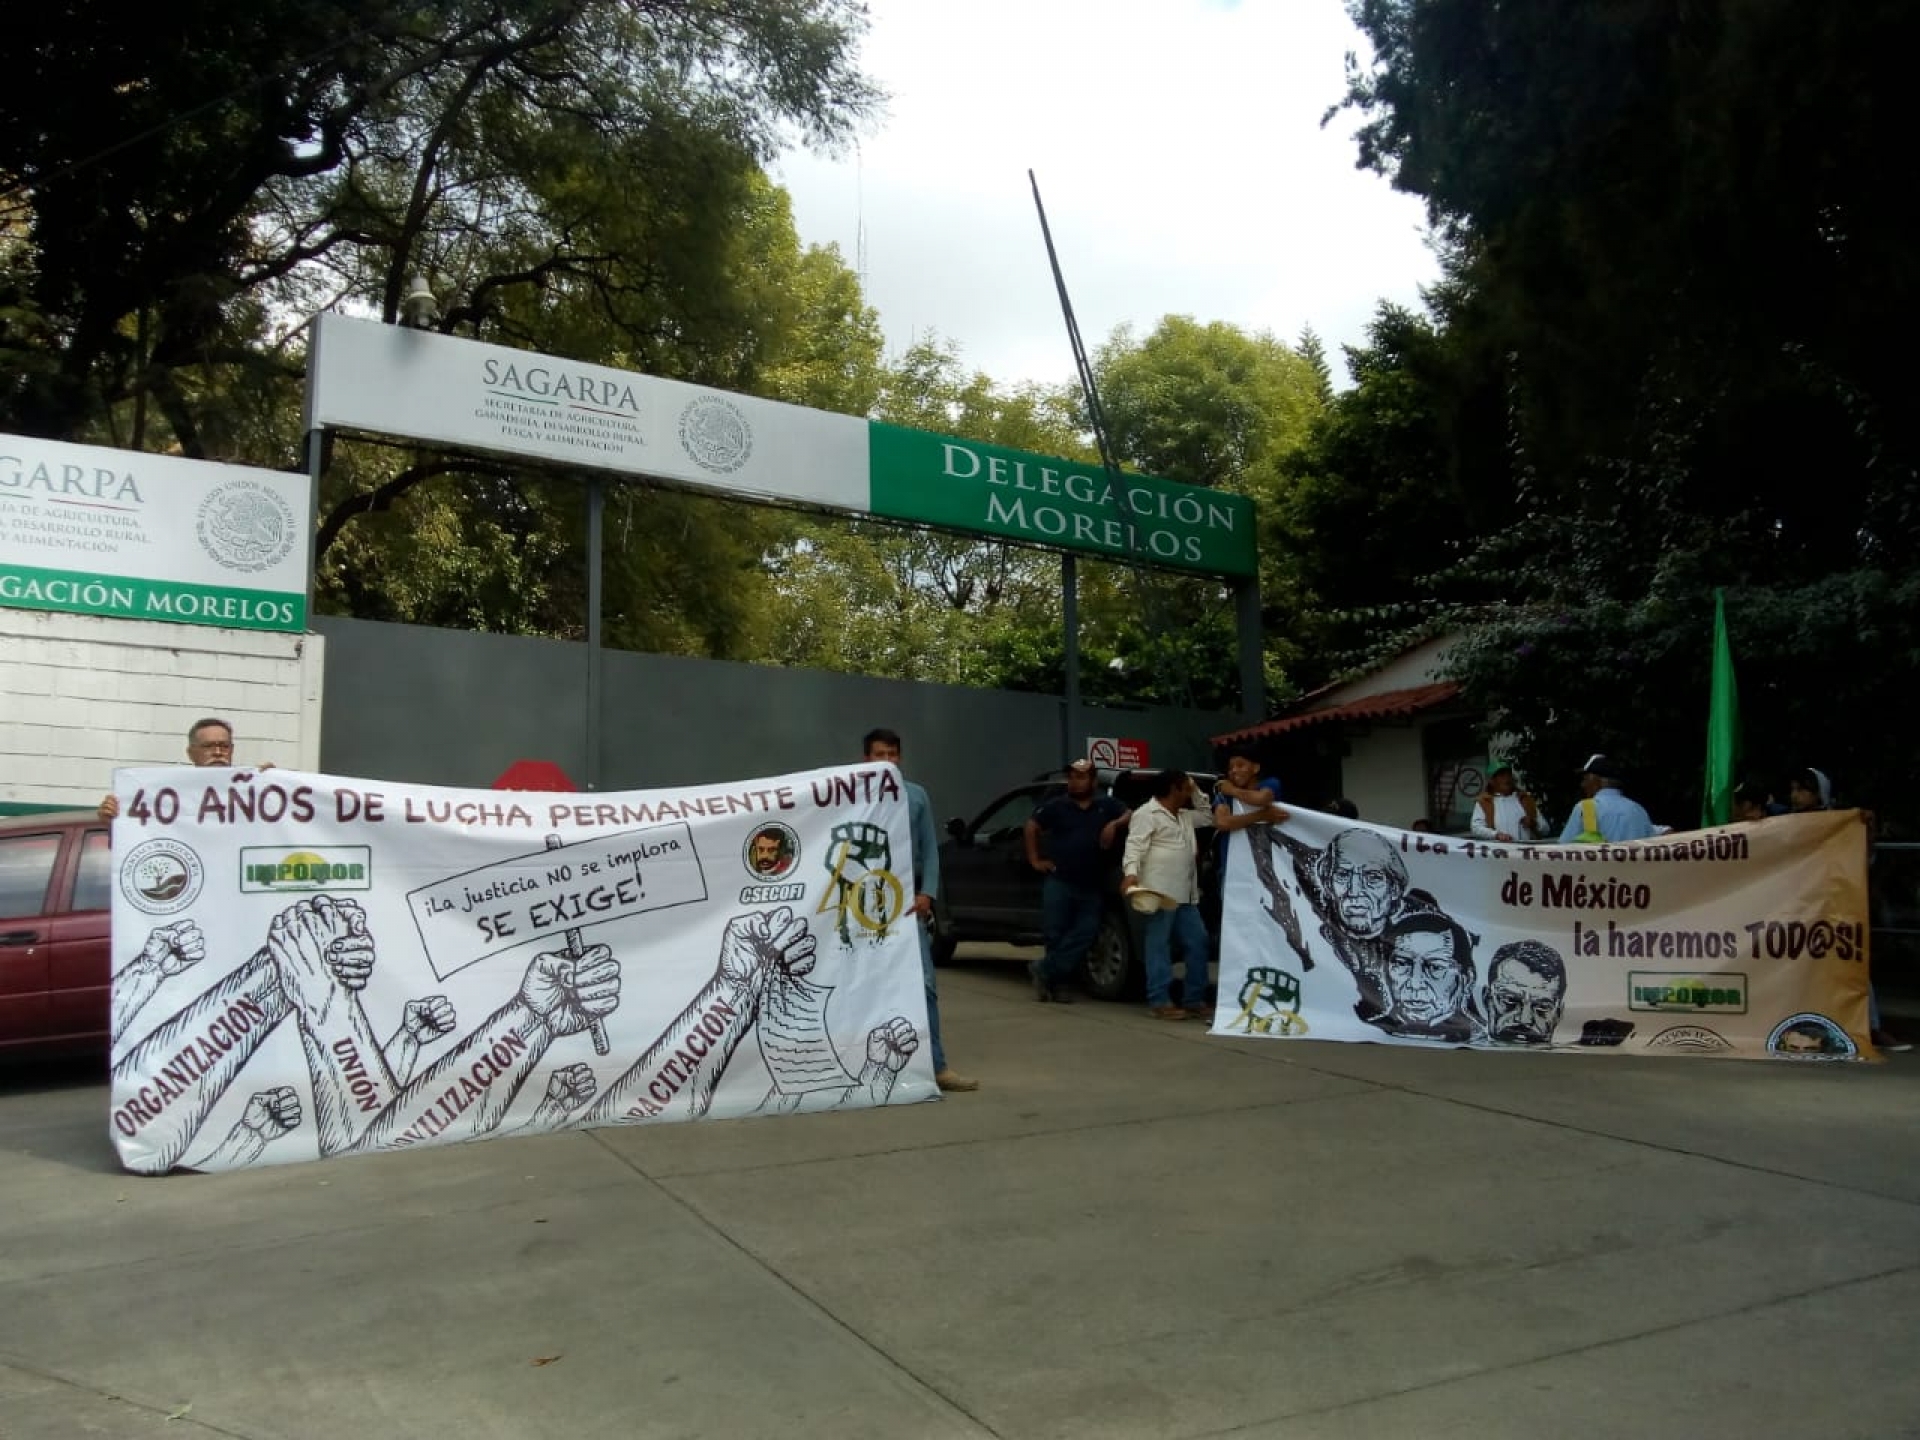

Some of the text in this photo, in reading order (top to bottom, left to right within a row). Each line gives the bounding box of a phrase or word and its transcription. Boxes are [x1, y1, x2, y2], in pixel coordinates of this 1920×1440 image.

[483, 359, 640, 412] SAGARPA
[21, 505, 40, 517] DE
[942, 443, 1237, 533] DELEGACIÓN
[12, 518, 102, 537] DESARROLLO
[985, 491, 1202, 562] MORELOS
[146, 591, 295, 624] MORELOS
[127, 768, 900, 828] 40 AÑOS DE LUCHA PERMANENTE UNTA
[461, 874, 540, 913] justicia
[546, 865, 572, 886] NO
[580, 860, 601, 877] se
[607, 838, 682, 873] implora
[1501, 871, 1652, 911] de México
[476, 872, 647, 944] SE EXIGE!
[1572, 919, 1865, 964] la haremos TOD@S!
[113, 991, 266, 1138] ORGANIZACIÓN
[332, 1036, 382, 1114] UNIÓN
